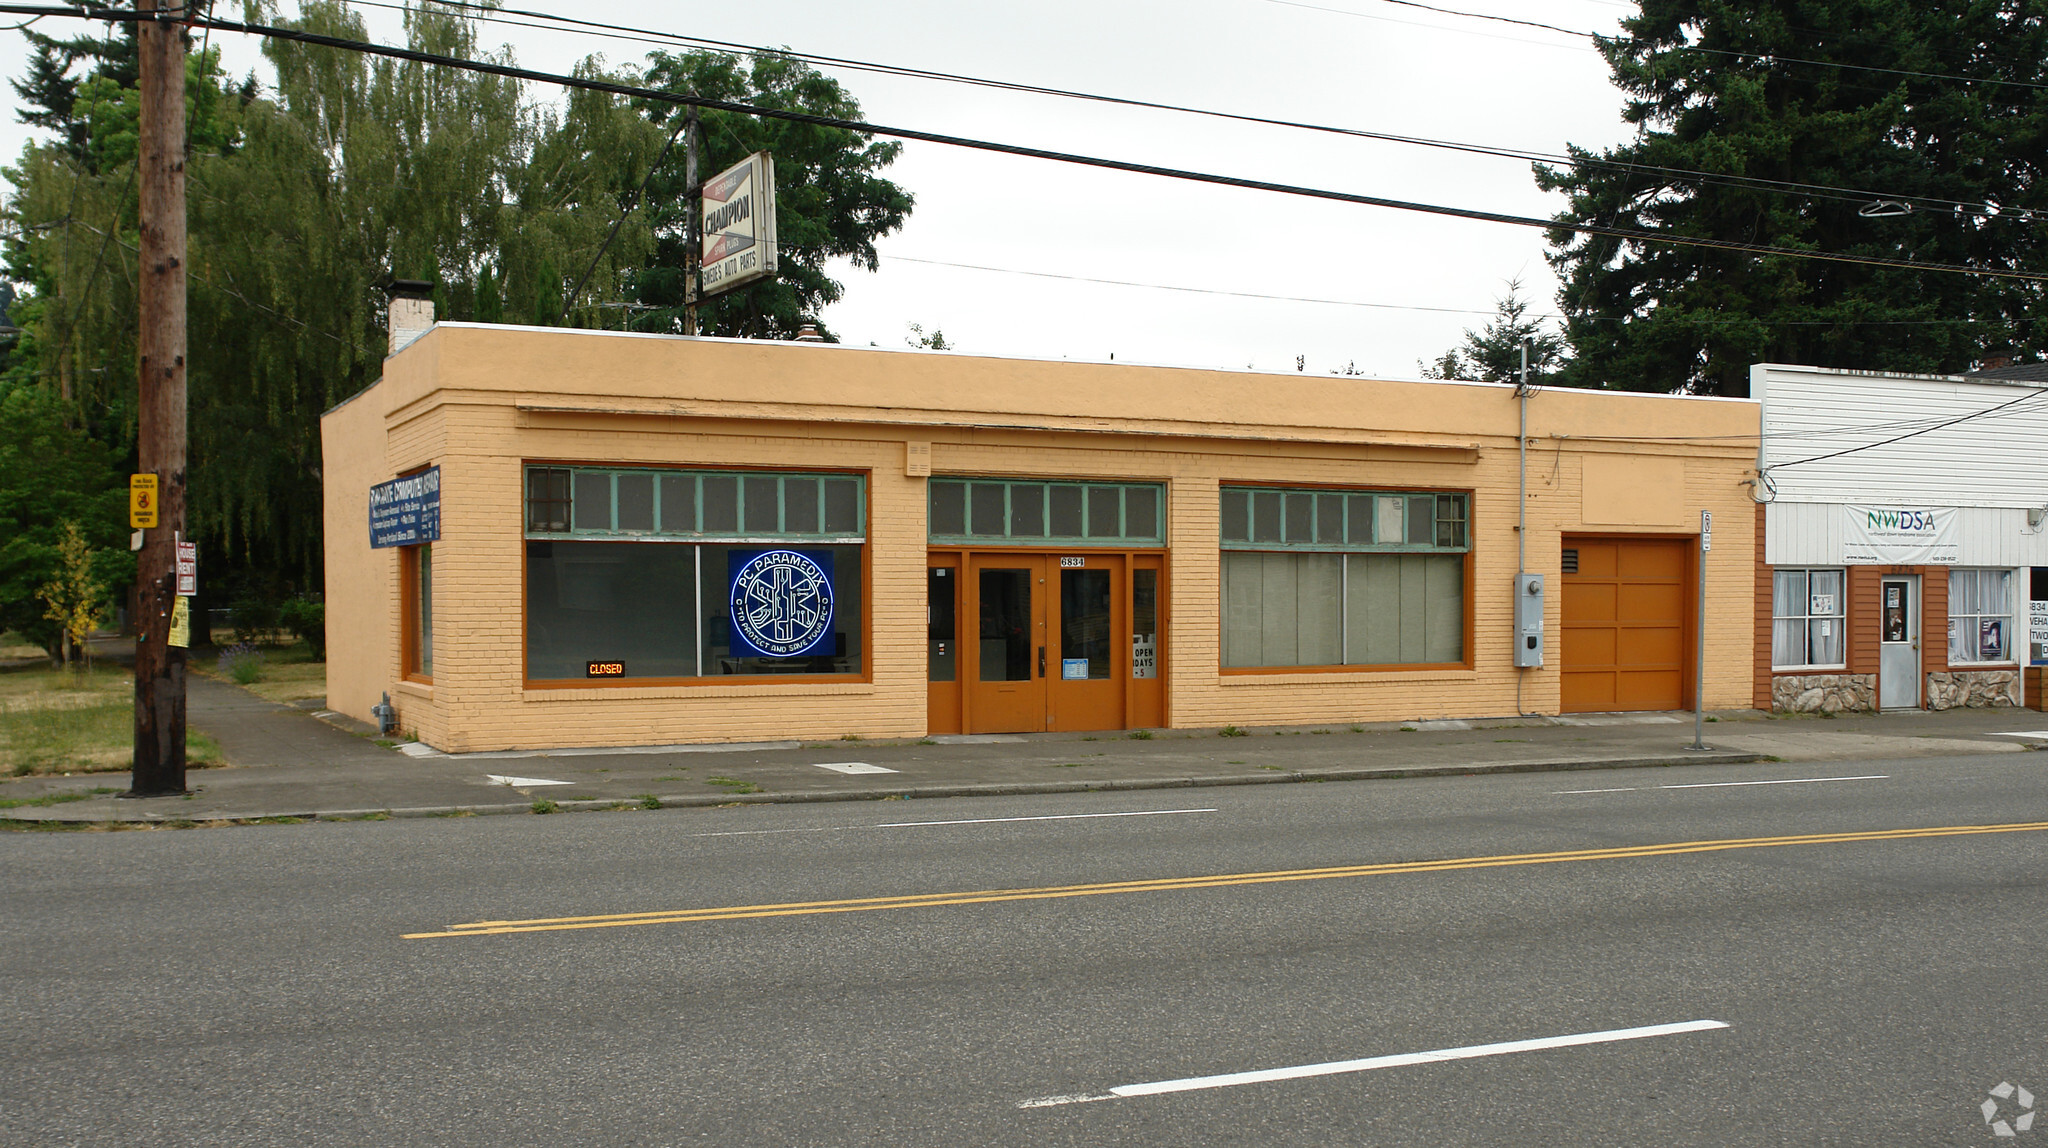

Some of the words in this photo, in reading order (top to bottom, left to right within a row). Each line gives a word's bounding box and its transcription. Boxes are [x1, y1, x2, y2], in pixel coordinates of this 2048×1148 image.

[714, 174, 737, 197] DEPENDABLE
[705, 194, 750, 237] CHAMPION
[714, 242, 726, 256] SPARK
[726, 237, 739, 251] PLUGS
[703, 262, 722, 286] SWEDE'S
[725, 257, 738, 277] AUTO
[740, 250, 756, 272] PARTS
[394, 477, 422, 501] COMPUTER
[423, 470, 439, 494] REPAIR
[1867, 510, 1936, 530] NWDSA
[178, 547, 196, 559] HOUSE
[1061, 557, 1084, 567] 6834
[178, 562, 195, 575] RENT
[739, 570, 754, 588] PC
[755, 553, 825, 588] PARAMEDIX
[737, 610, 745, 622] TO
[741, 622, 770, 649] PROTECT
[770, 645, 787, 653] AND
[788, 639, 808, 651] SAVE
[807, 622, 824, 641] YOUR
[820, 610, 828, 621] PC
[1135, 648, 1153, 657] OPEN
[590, 664, 622, 674] CLOSED
